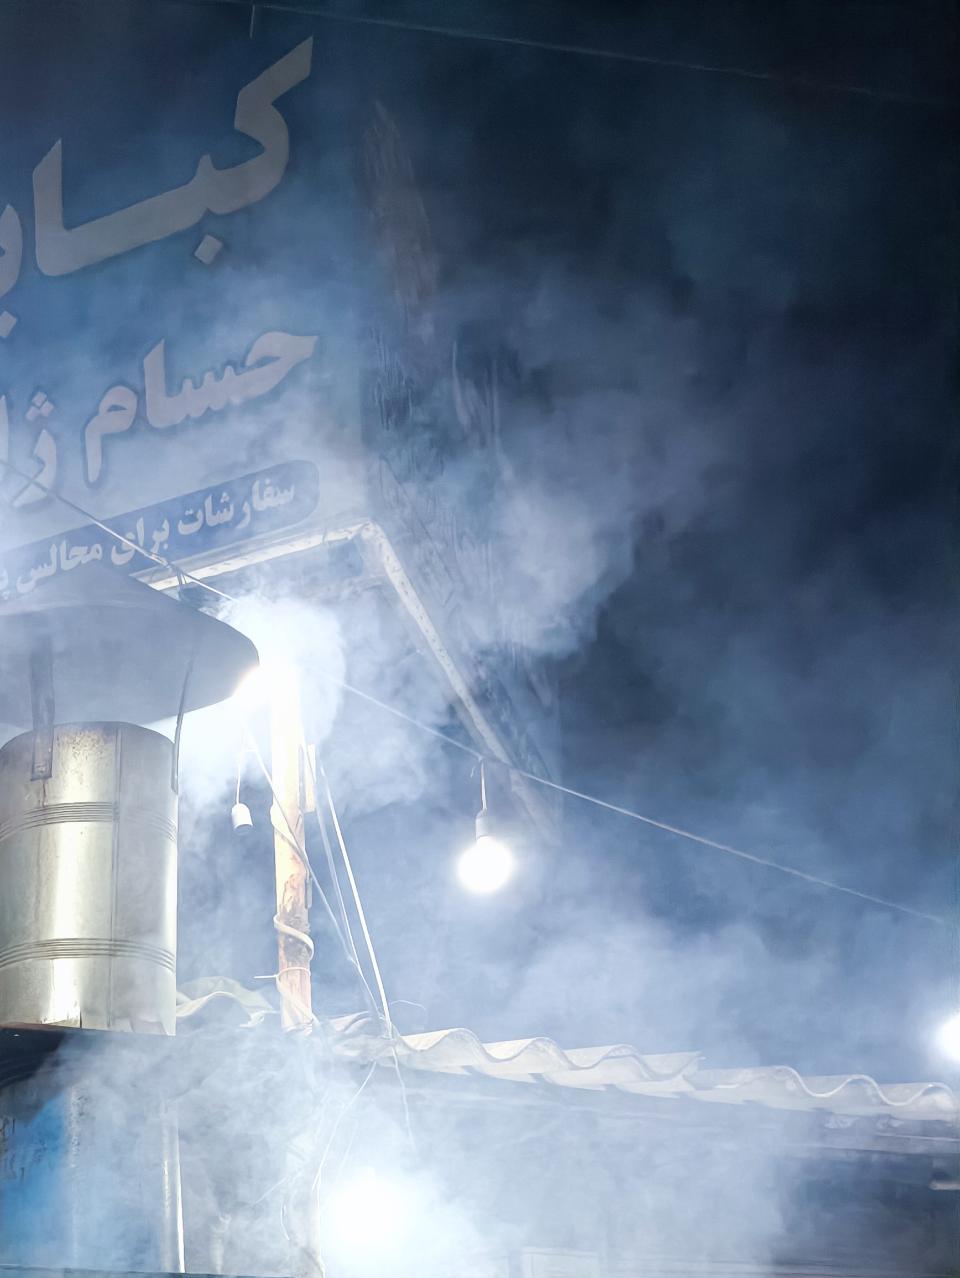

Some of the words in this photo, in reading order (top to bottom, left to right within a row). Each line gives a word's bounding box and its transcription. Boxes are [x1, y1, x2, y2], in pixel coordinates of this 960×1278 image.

[84, 324, 320, 483] حسام
[177, 476, 296, 537] سفارشات
[110, 517, 170, 566] برای
